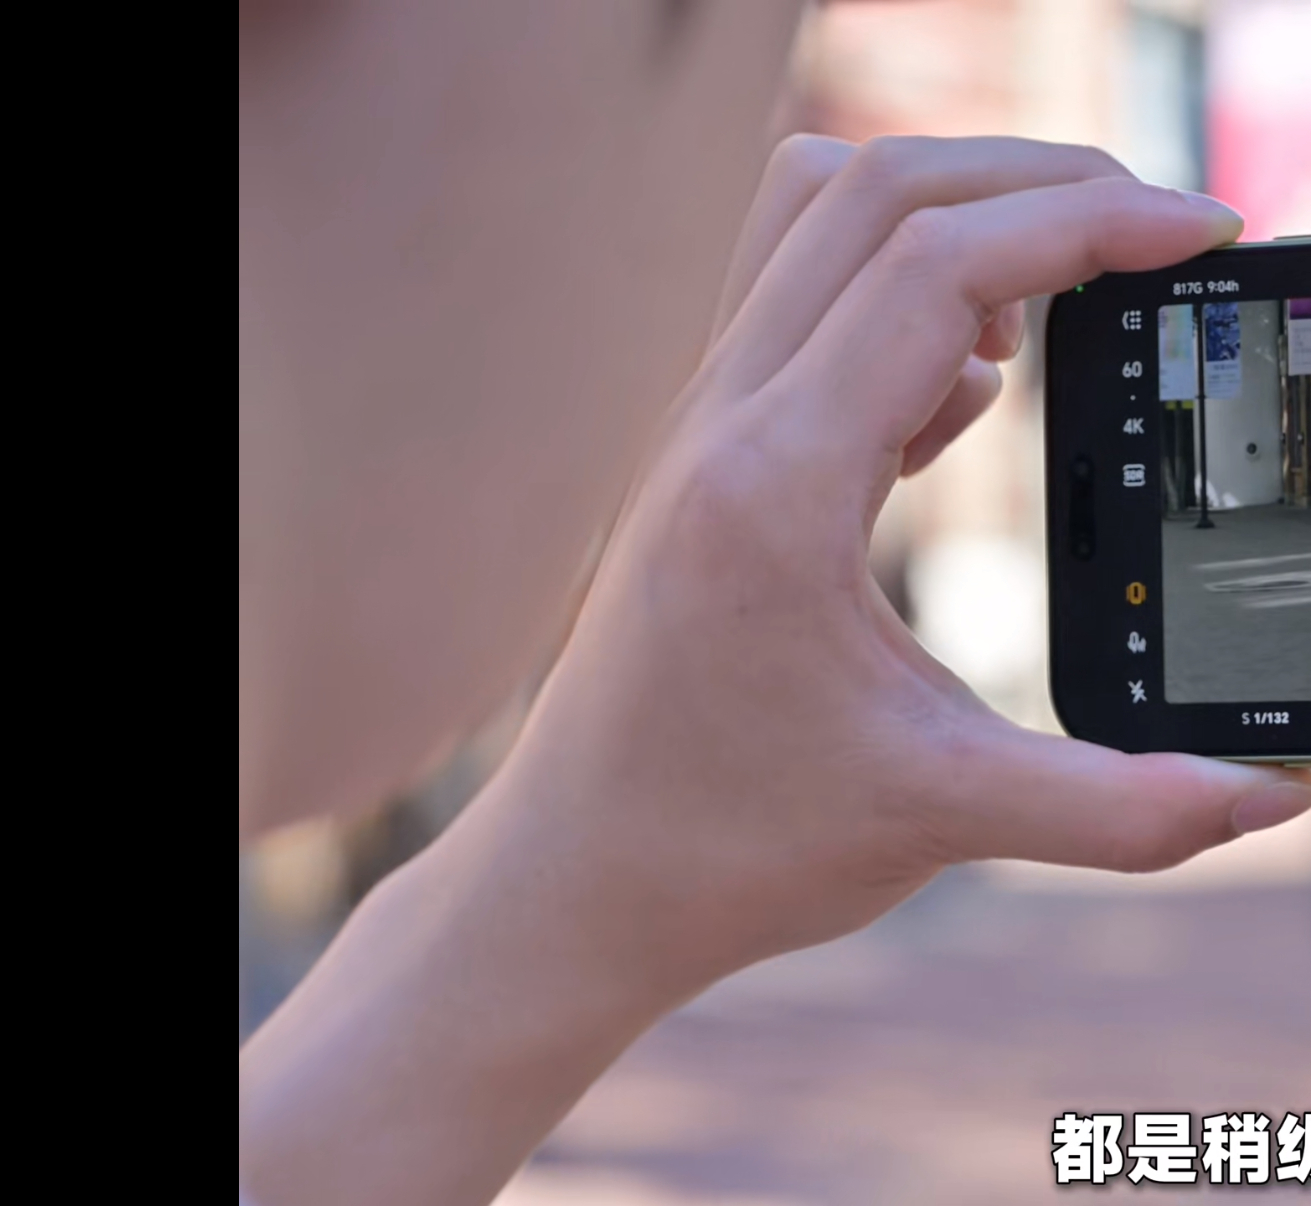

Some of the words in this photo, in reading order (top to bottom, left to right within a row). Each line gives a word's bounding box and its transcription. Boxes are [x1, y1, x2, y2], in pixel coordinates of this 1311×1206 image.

[1172, 282, 1203, 296] 817G
[1207, 280, 1239, 294] 9:04h
[1122, 361, 1142, 379] 60
[1123, 419, 1144, 434] 4K
[1241, 712, 1250, 725] S
[1253, 711, 1290, 726] 1/132
